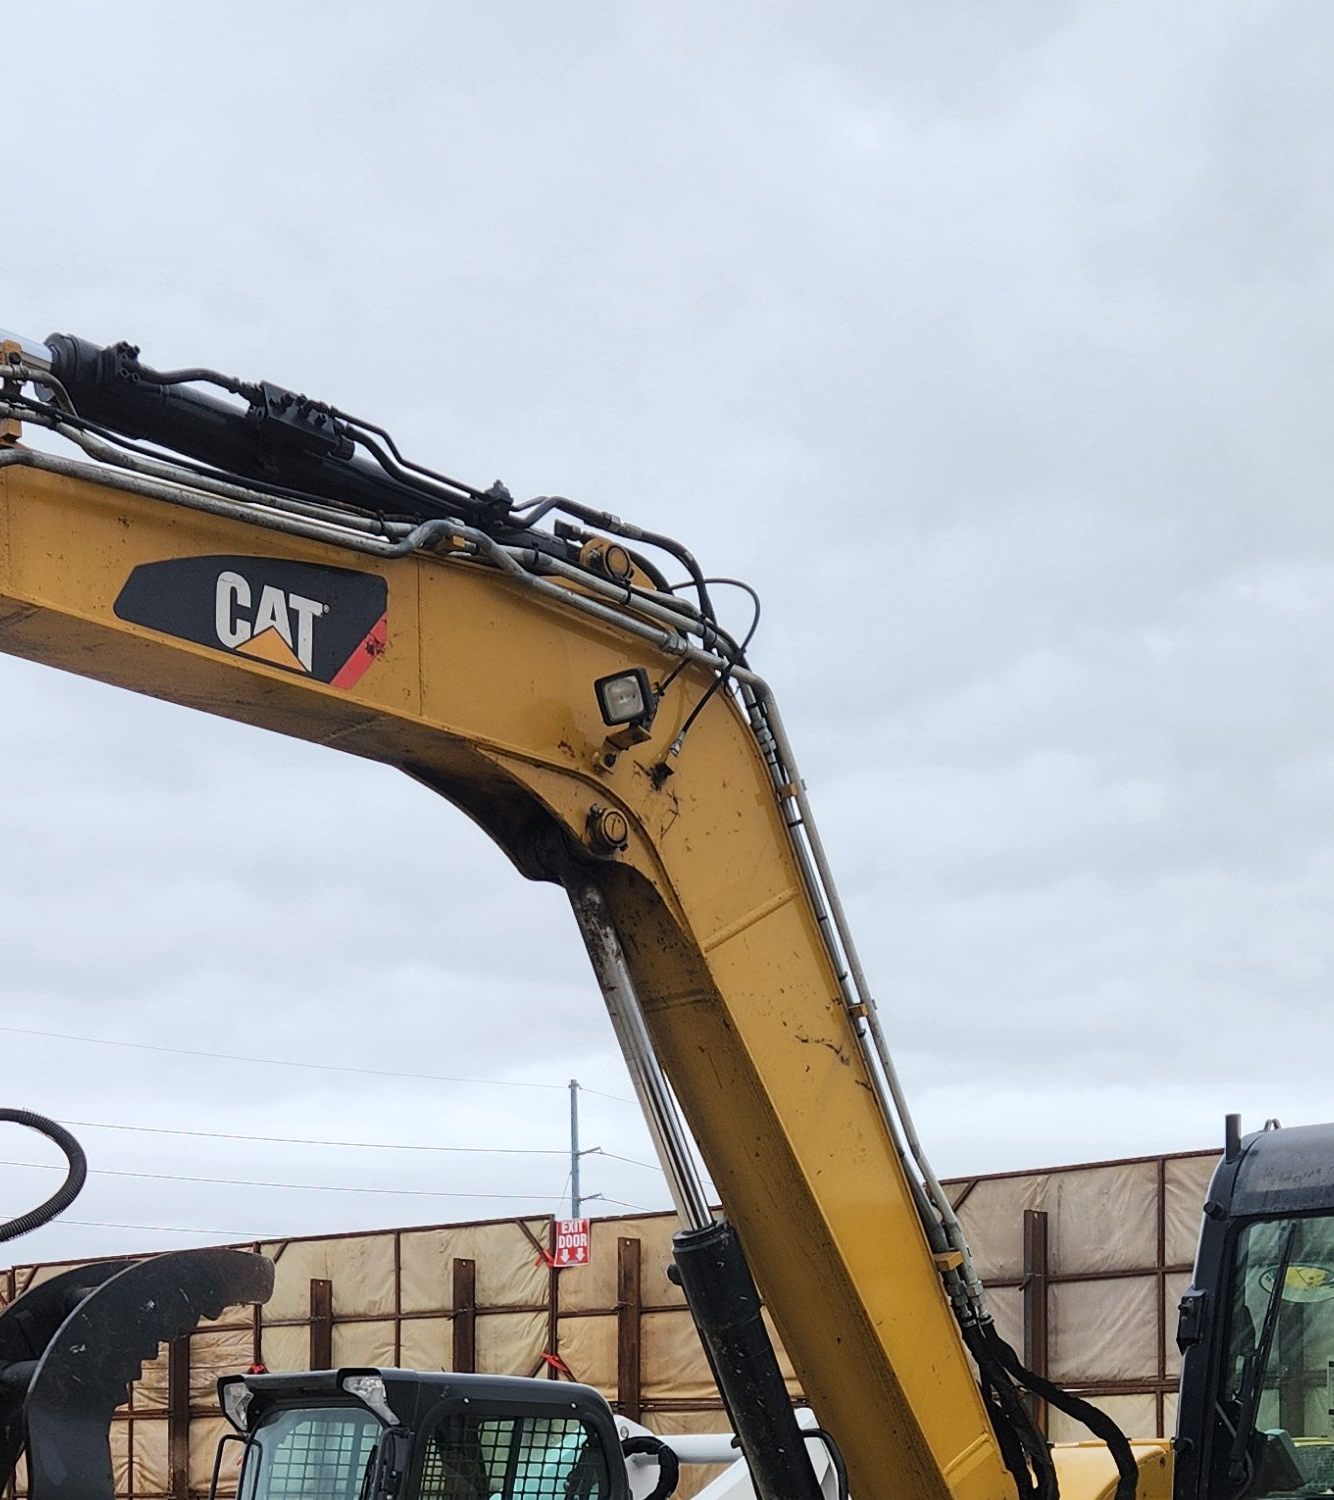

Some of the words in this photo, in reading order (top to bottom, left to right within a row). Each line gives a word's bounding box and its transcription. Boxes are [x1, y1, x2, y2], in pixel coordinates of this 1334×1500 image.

[216, 570, 321, 672] CAT
[561, 1220, 583, 1233] EXIT
[558, 1233, 587, 1248] DOOR
